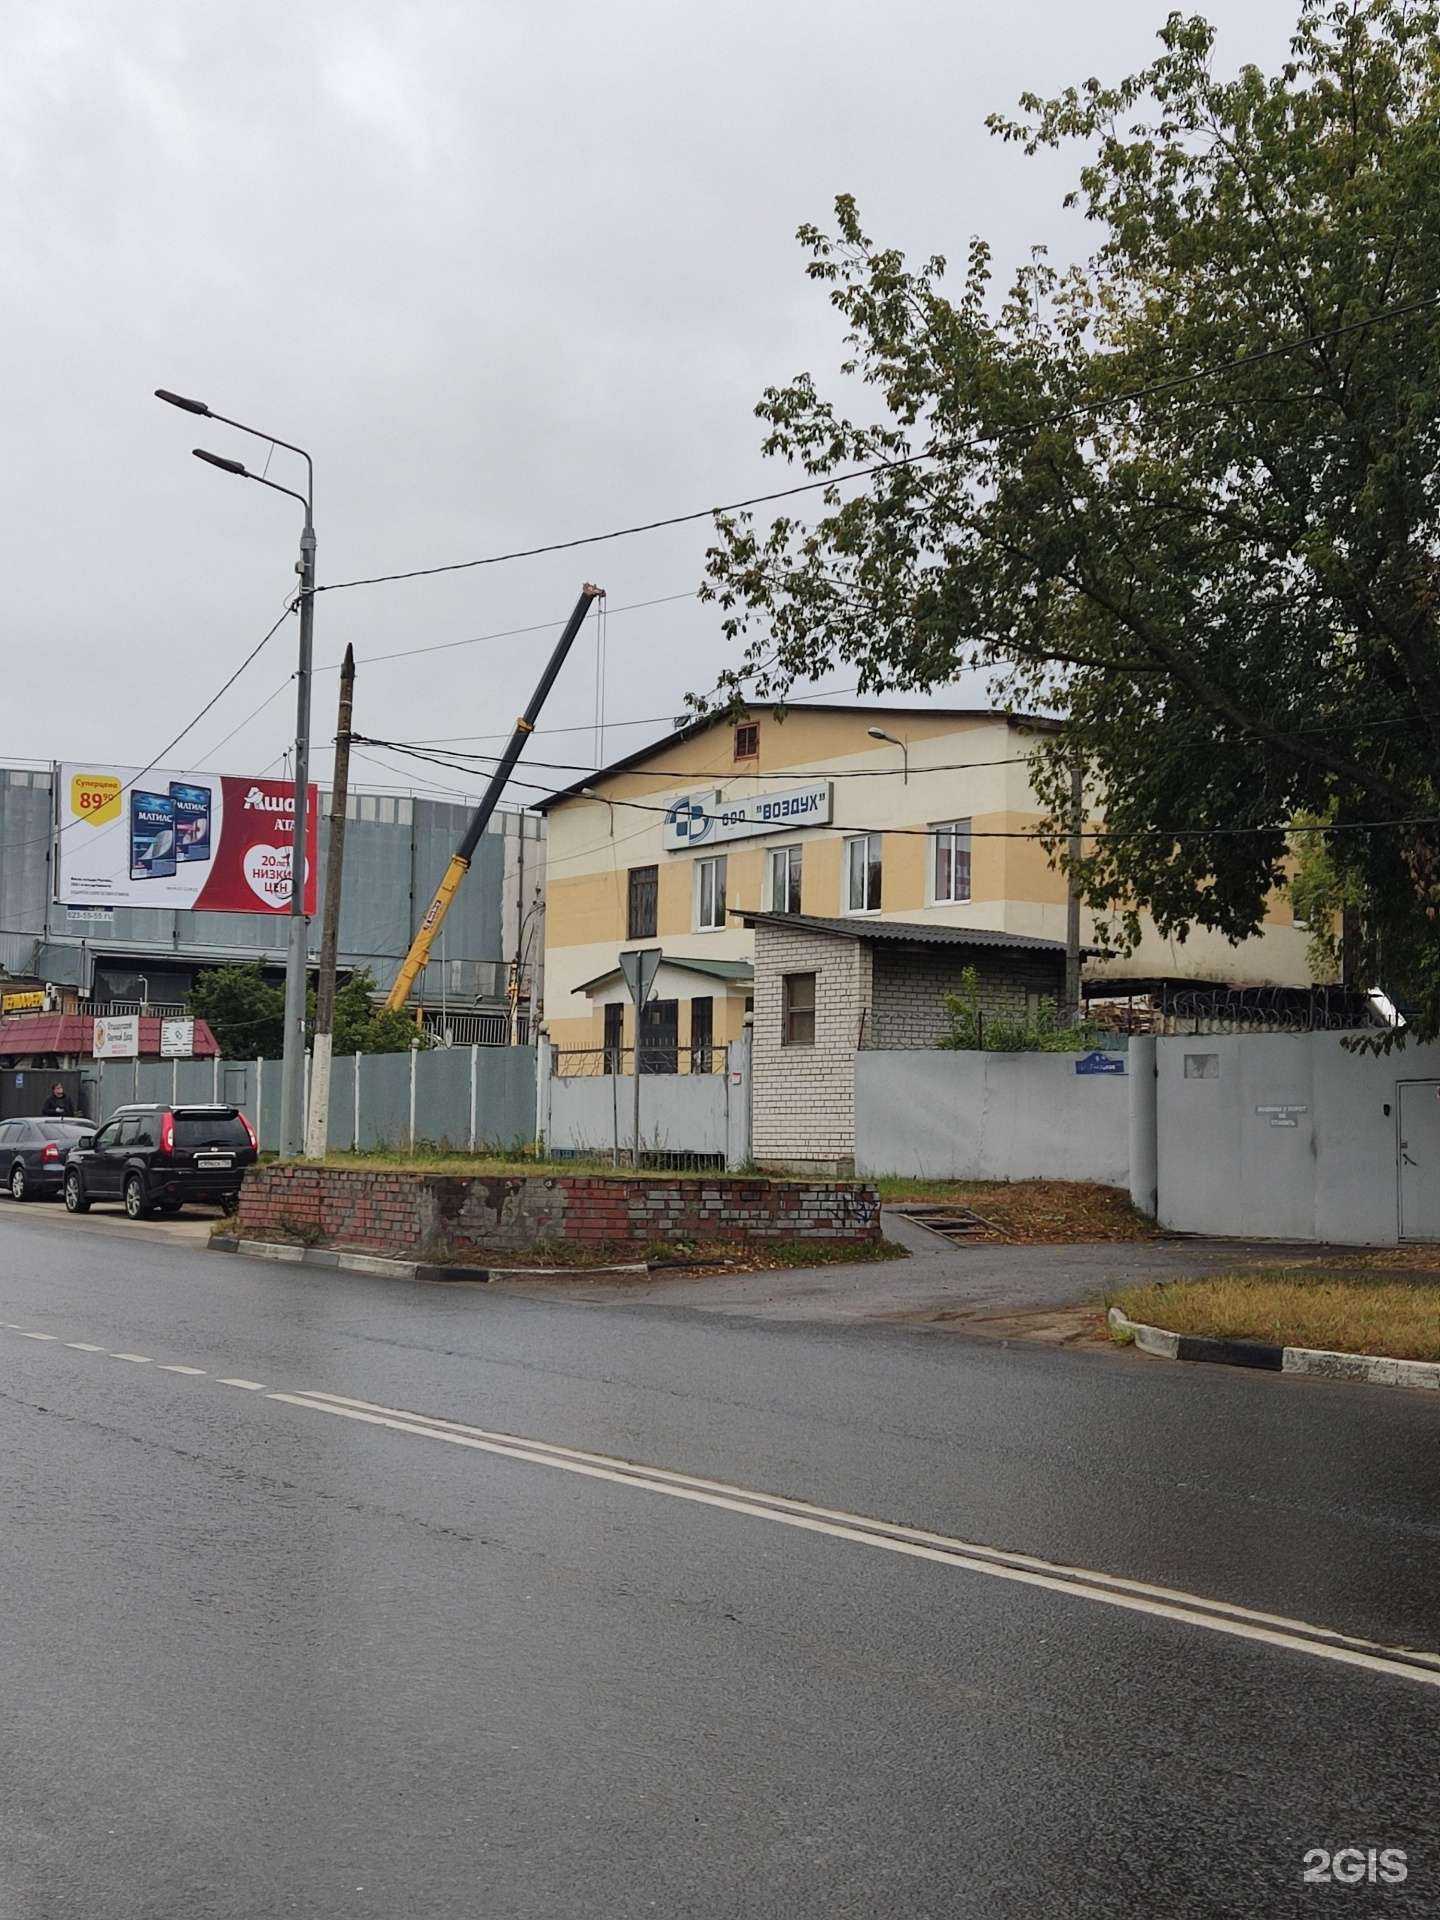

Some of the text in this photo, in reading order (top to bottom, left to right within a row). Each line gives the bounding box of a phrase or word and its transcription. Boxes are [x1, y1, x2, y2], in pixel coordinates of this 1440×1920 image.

[80, 793, 102, 809] 89
[244, 787, 310, 814] Аша
[138, 811, 173, 823] МАТИАС
[252, 869, 293, 879] НИЗКИ
